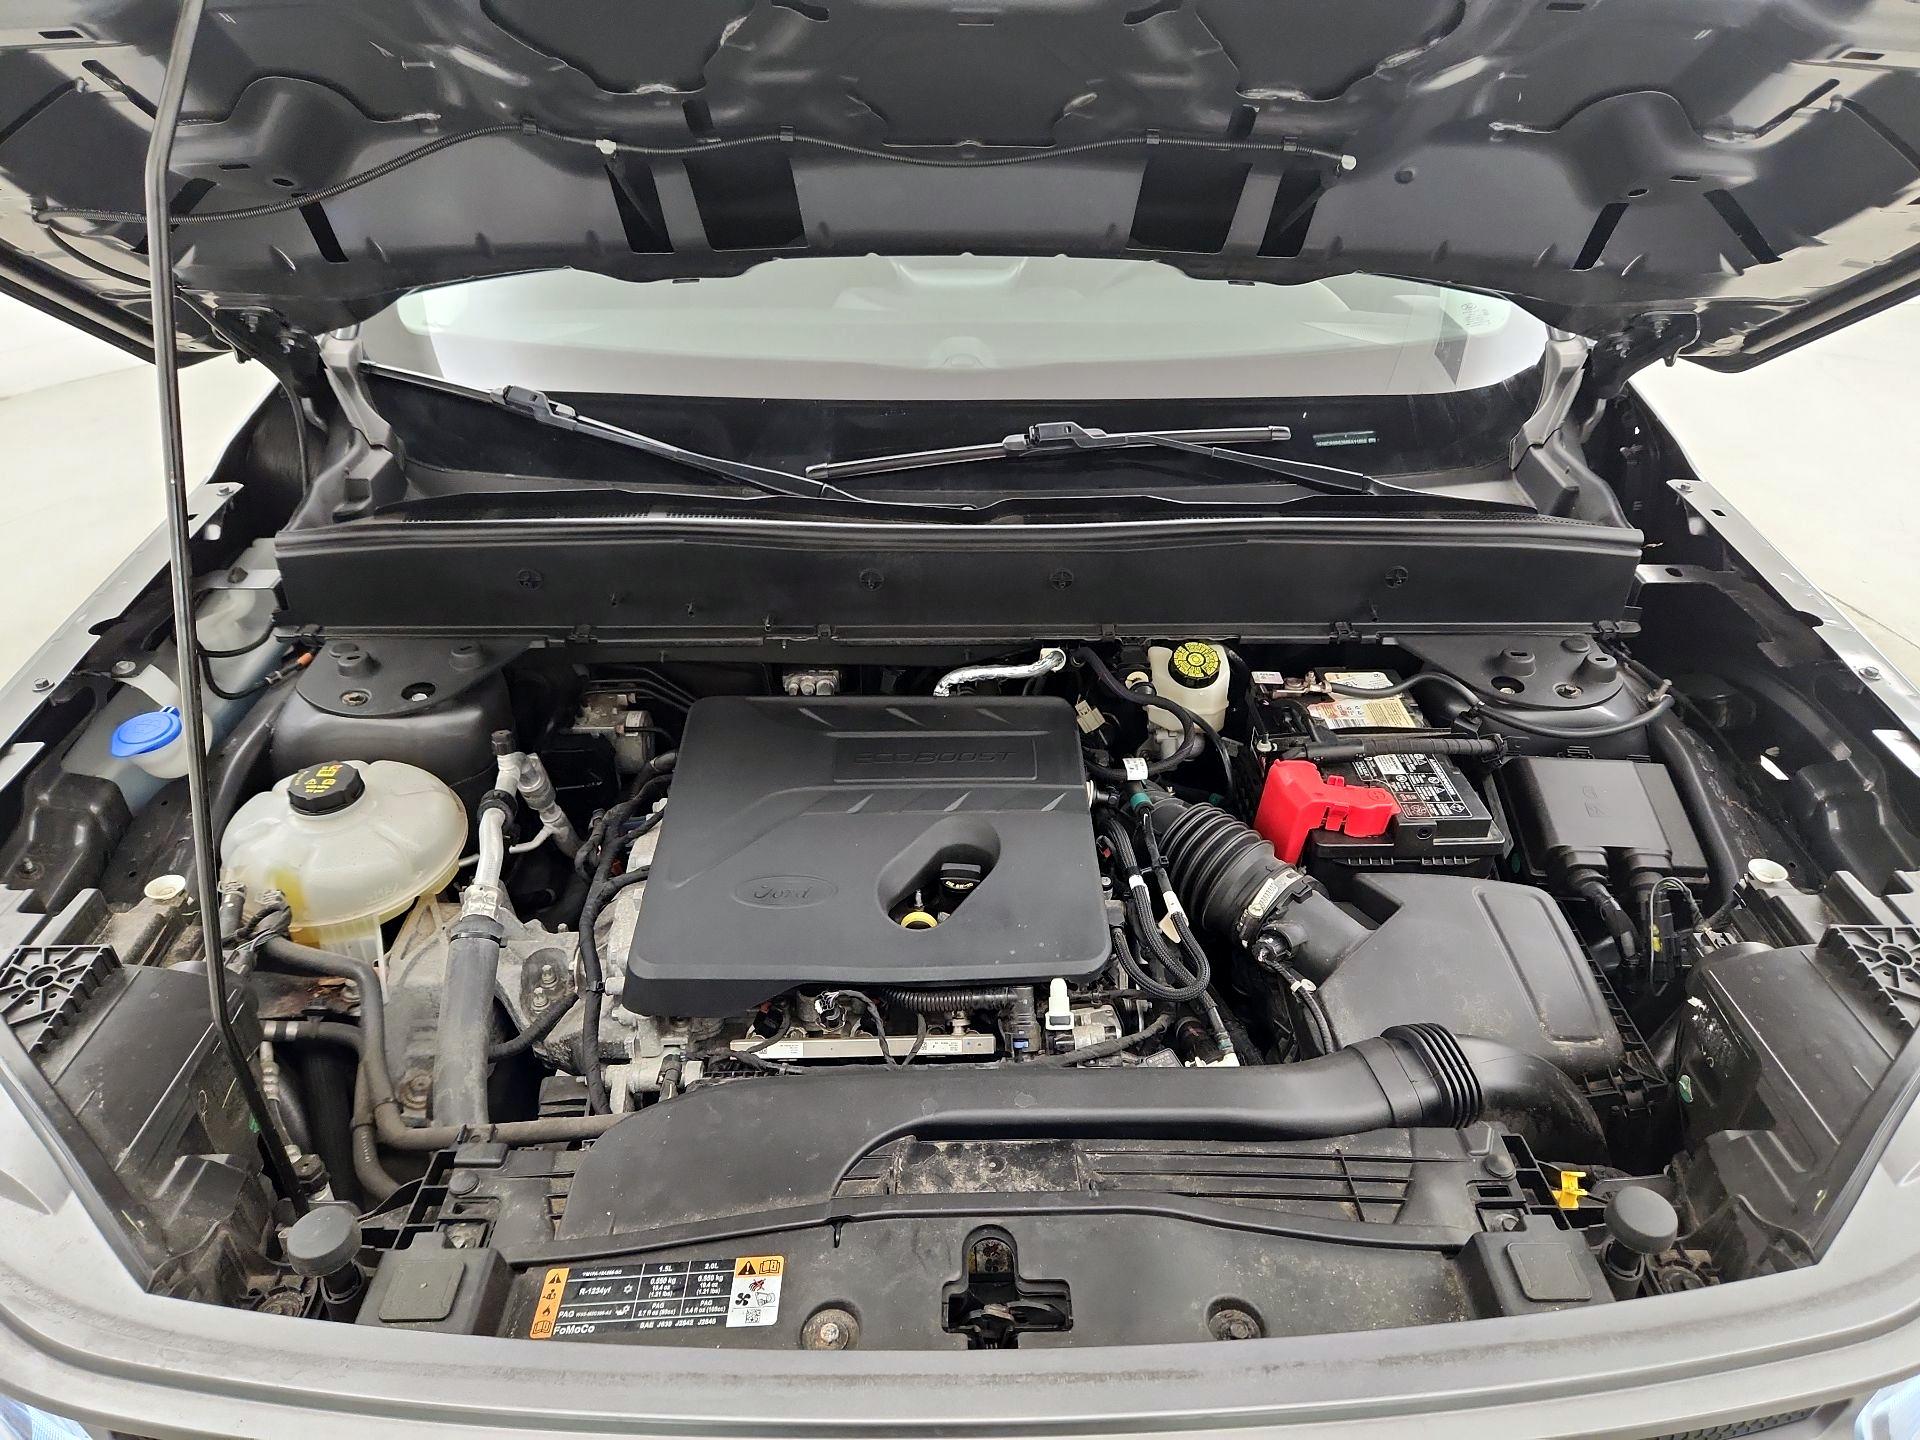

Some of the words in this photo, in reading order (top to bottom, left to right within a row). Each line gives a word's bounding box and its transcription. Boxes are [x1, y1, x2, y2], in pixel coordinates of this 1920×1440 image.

[753, 884, 814, 900] Ford
[658, 1264, 673, 1273] 1.5L
[704, 1262, 719, 1270] 2.0L
[667, 1276, 677, 1285] kg
[714, 1273, 724, 1283] kg
[553, 1324, 596, 1336] FoMoCo
